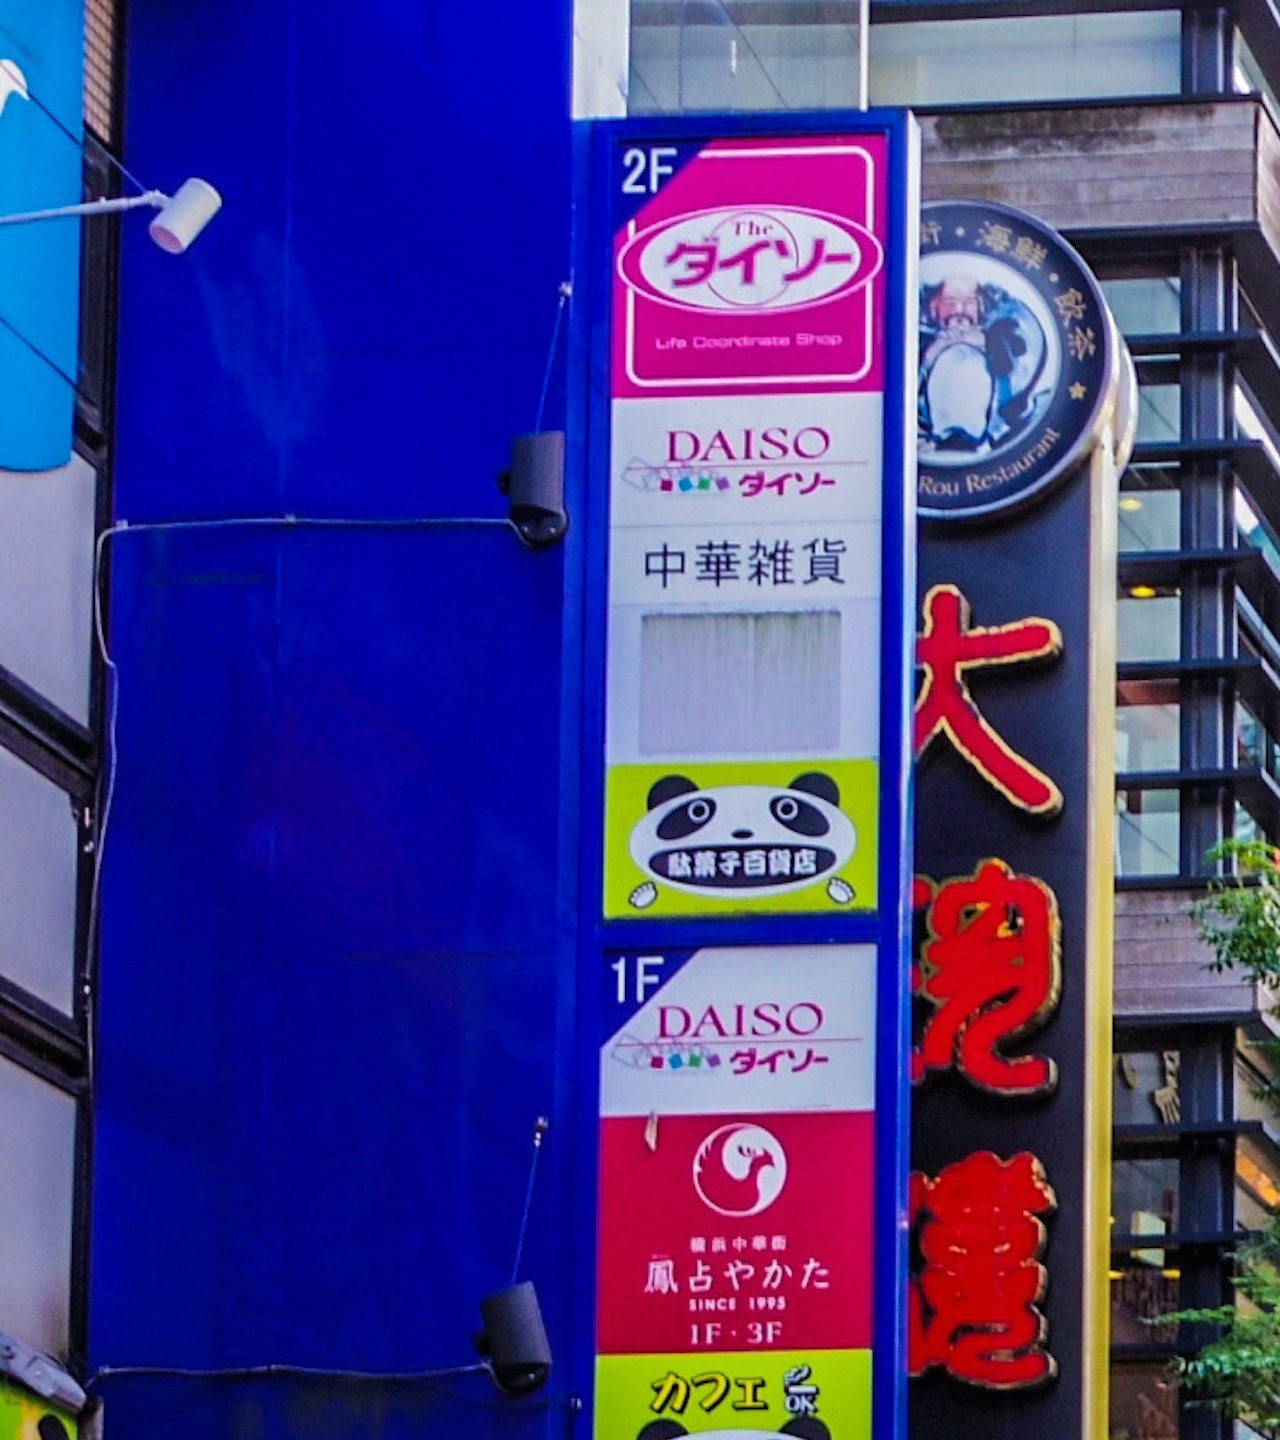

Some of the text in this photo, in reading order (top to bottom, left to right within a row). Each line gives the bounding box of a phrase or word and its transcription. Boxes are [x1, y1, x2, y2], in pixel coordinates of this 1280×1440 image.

[622, 148, 678, 194] 2F
[734, 220, 774, 236] The
[664, 237, 854, 288] ダイソー
[655, 333, 843, 351] Life Coordinate Shop
[667, 427, 832, 463] DAISO
[965, 426, 1062, 493] Restaurant
[738, 471, 836, 497] ダイソー
[645, 538, 847, 588] 中華雑貨
[667, 849, 818, 878] 駄菓子百貨店
[611, 956, 664, 1004] 1F
[658, 1002, 824, 1038] DAISO
[730, 1048, 830, 1074] ダイソー
[645, 1257, 830, 1295] 鳳占やかた
[689, 1296, 786, 1312] SINCE 1995
[784, 1395, 817, 1414] OK
